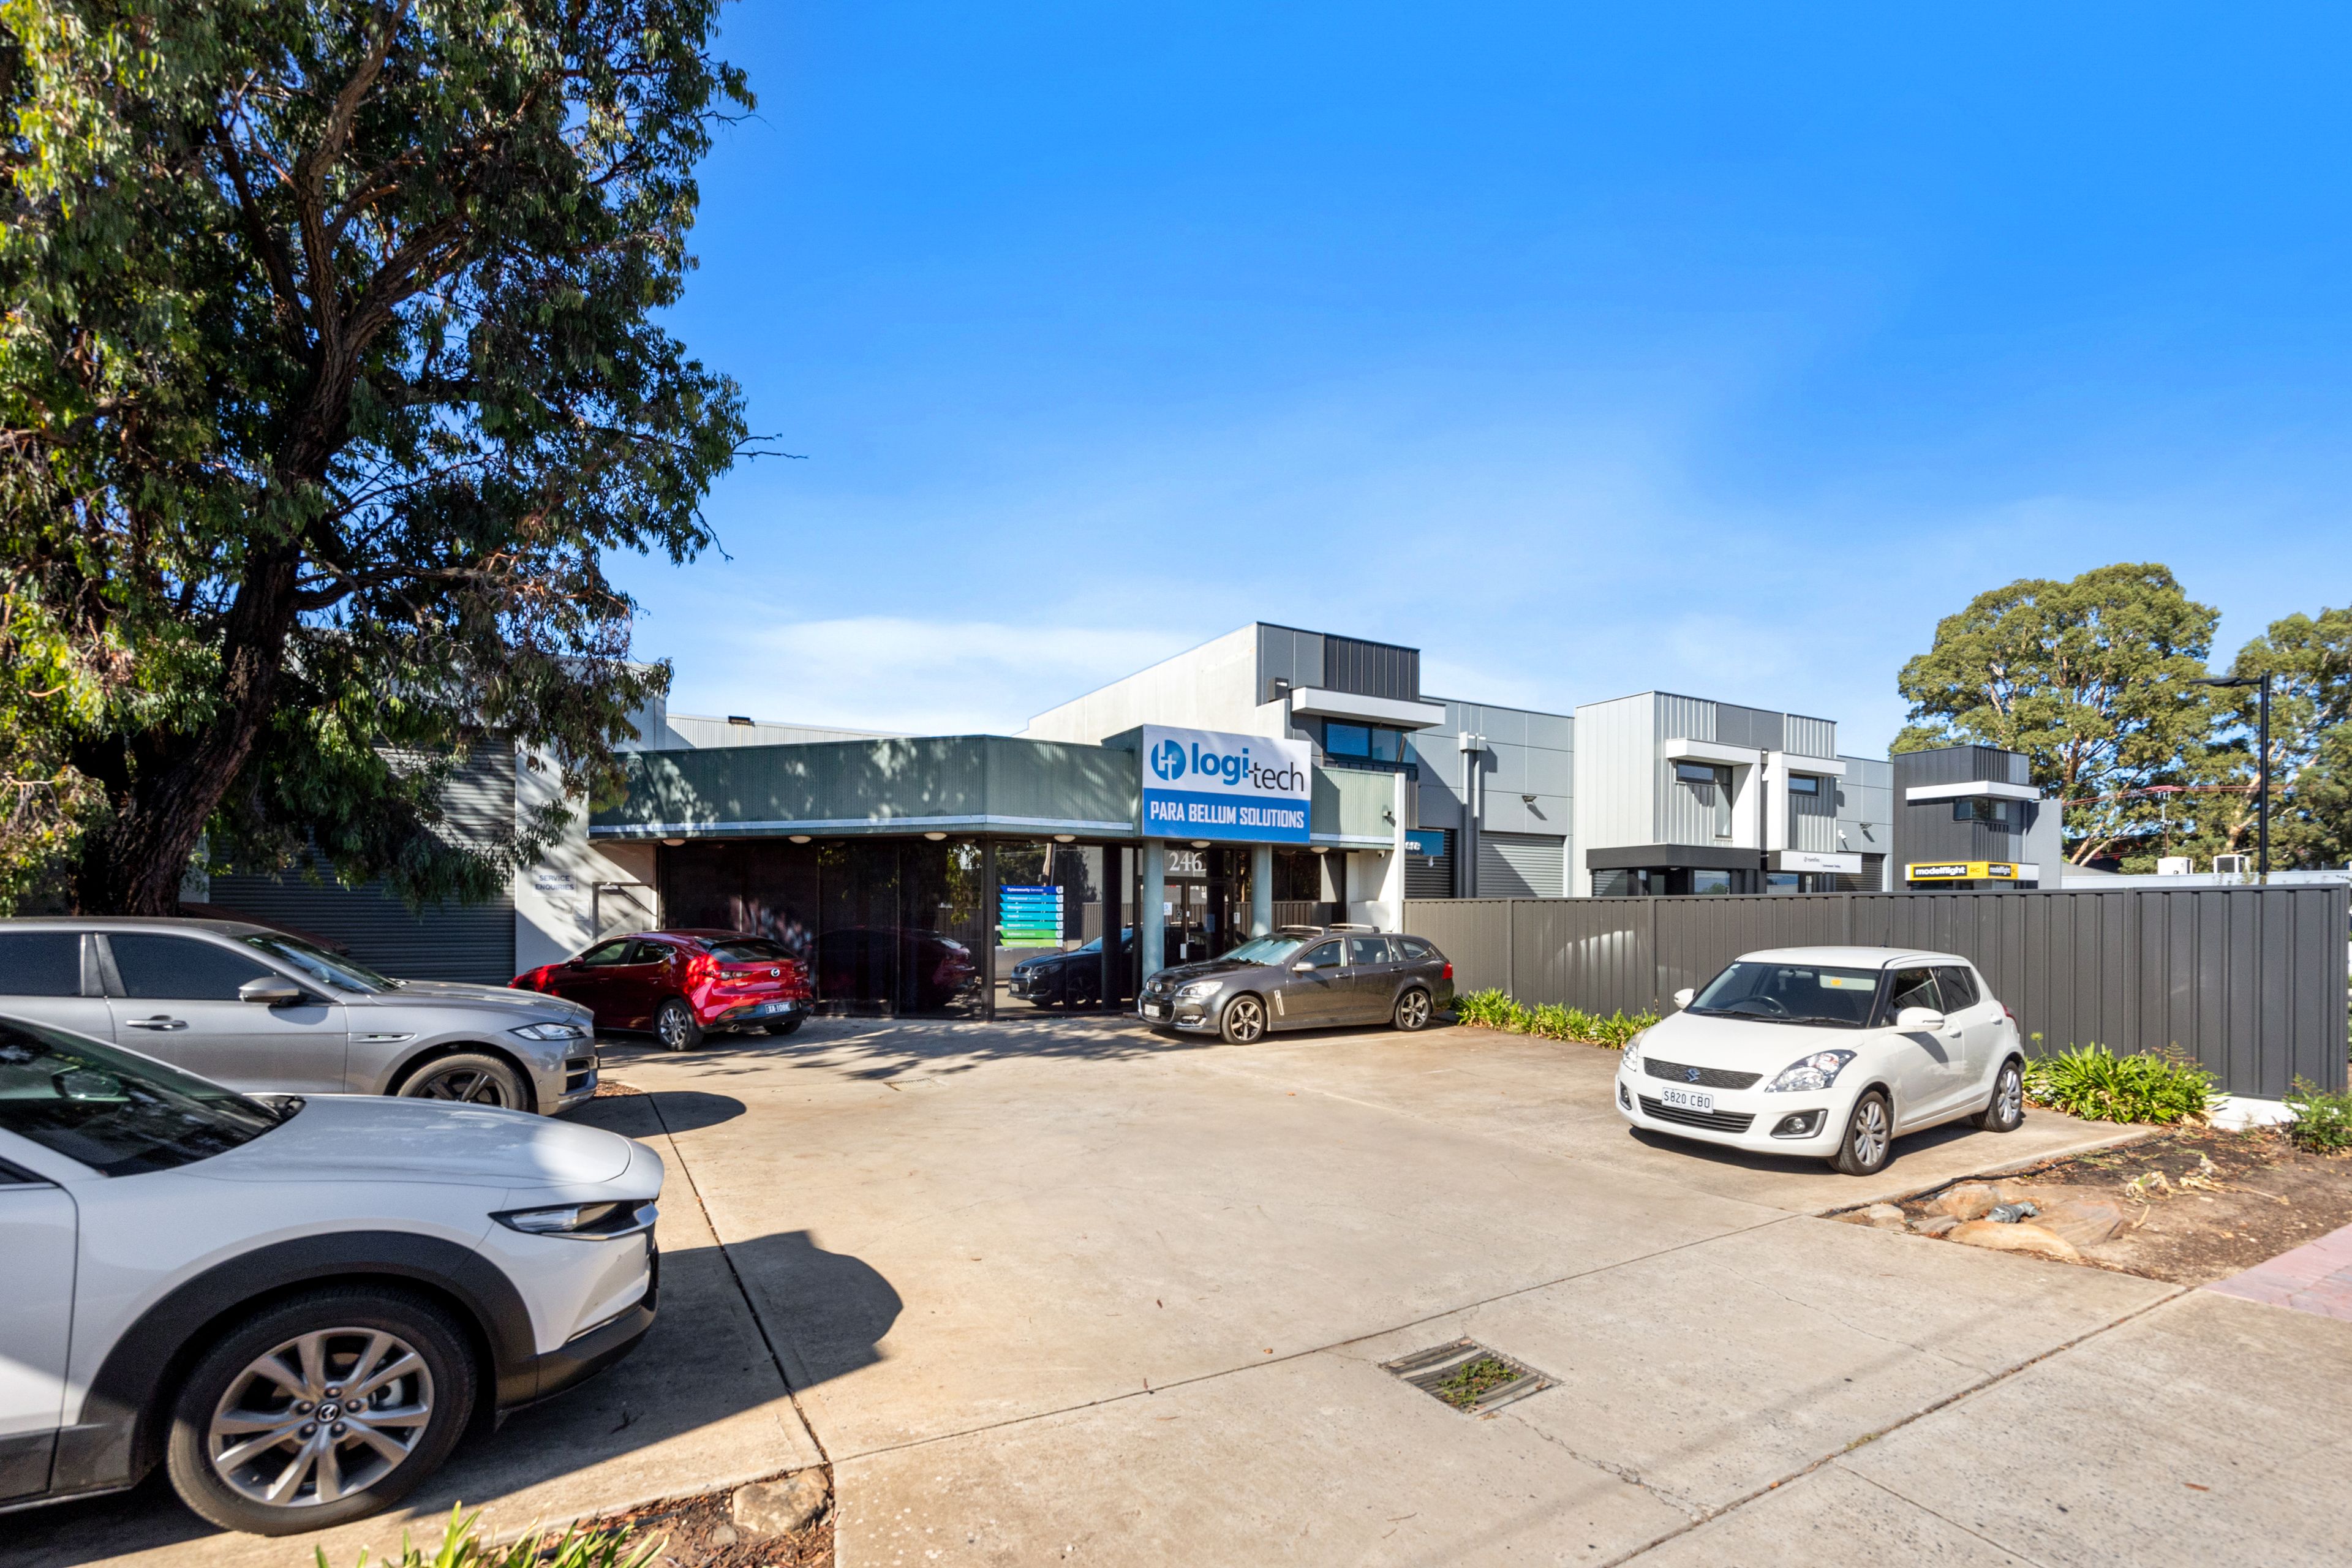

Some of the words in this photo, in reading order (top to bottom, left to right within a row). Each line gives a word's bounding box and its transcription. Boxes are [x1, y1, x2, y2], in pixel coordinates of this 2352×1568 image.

[1150, 801, 1185, 822] PARA
[1188, 804, 1236, 824] BELLUM
[1240, 807, 1305, 829] SOLUTIONS
[1169, 851, 1203, 872] 246
[1915, 865, 1966, 876] modelflight
[1664, 1091, 1686, 1104] S820
